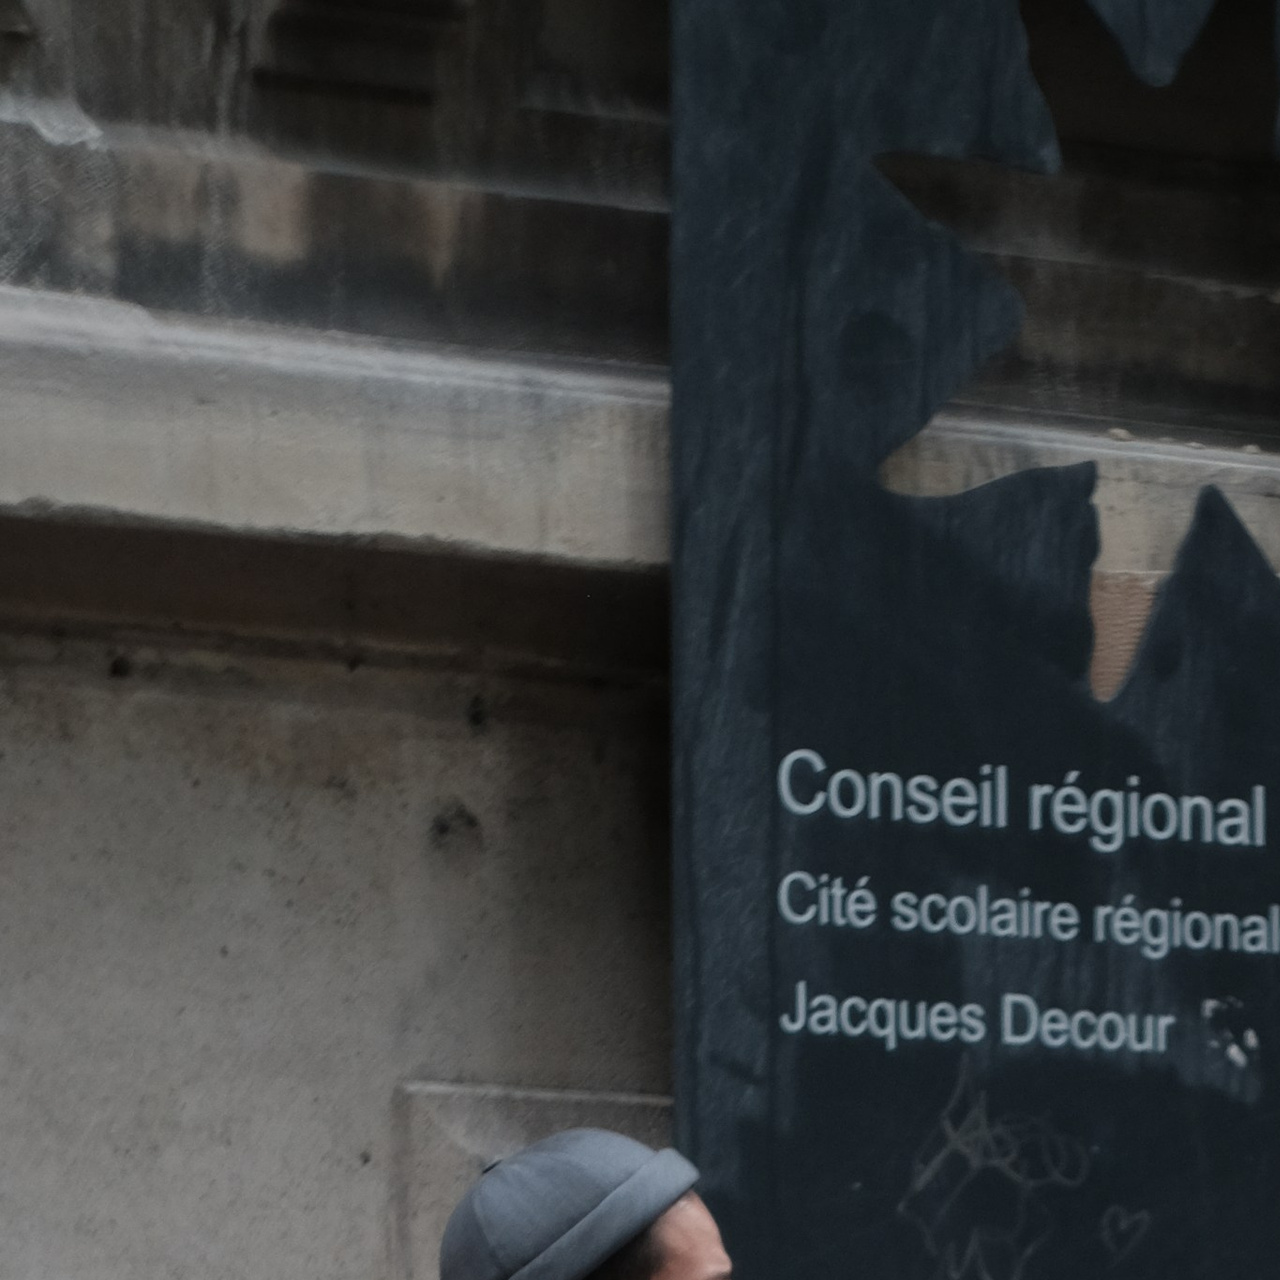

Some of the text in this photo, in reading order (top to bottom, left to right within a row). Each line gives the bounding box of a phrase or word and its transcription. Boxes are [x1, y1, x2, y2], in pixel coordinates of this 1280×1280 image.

[778, 749, 1266, 853] Conseil régional
[778, 871, 877, 928] Cité
[892, 885, 1079, 941] scolaire
[780, 980, 1177, 1053] Jacques Decour
